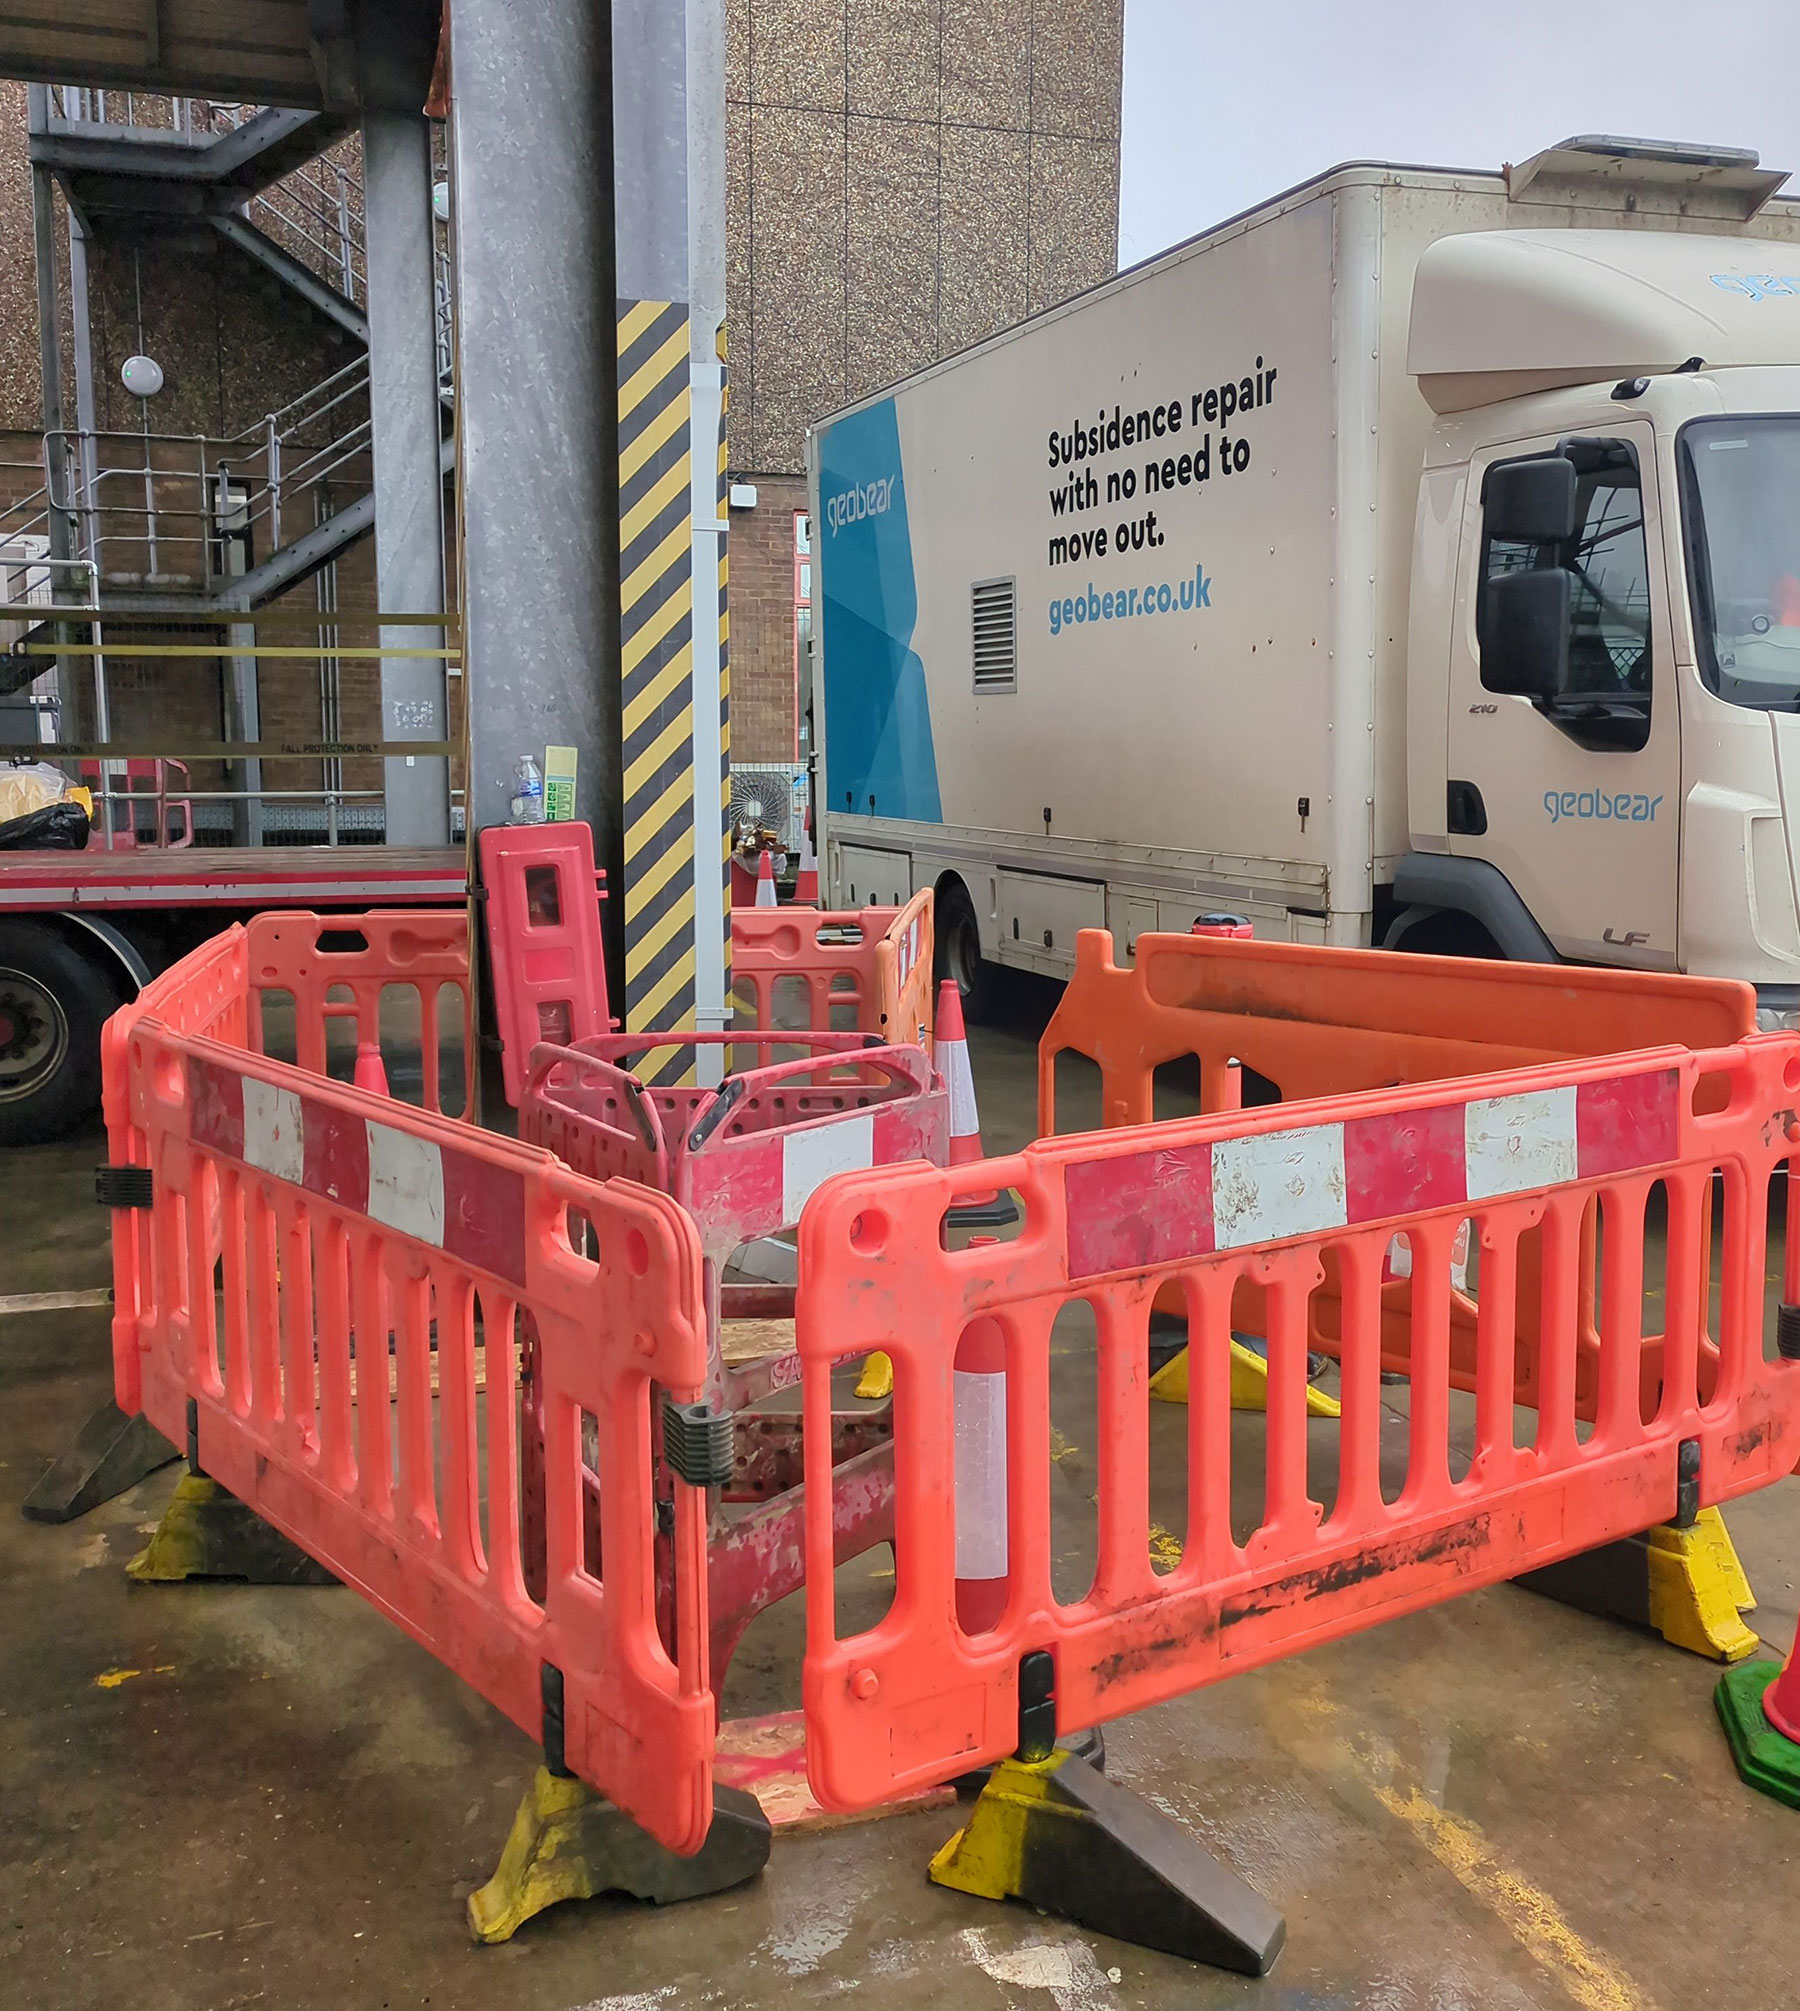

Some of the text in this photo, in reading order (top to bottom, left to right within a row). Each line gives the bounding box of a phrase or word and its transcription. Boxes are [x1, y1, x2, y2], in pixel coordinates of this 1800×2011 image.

[1049, 355, 1277, 468] Subsidence repair
[1049, 433, 1251, 517] with no need to
[827, 474, 895, 538] geobear
[1049, 511, 1164, 566] move out.
[1049, 565, 1212, 635] geobear.co.uk
[1469, 704, 1498, 714] 210
[281, 744, 378, 753] FALL PROTECTION ONLY
[1544, 788, 1663, 823] geobear
[1603, 927, 1650, 946] LF
